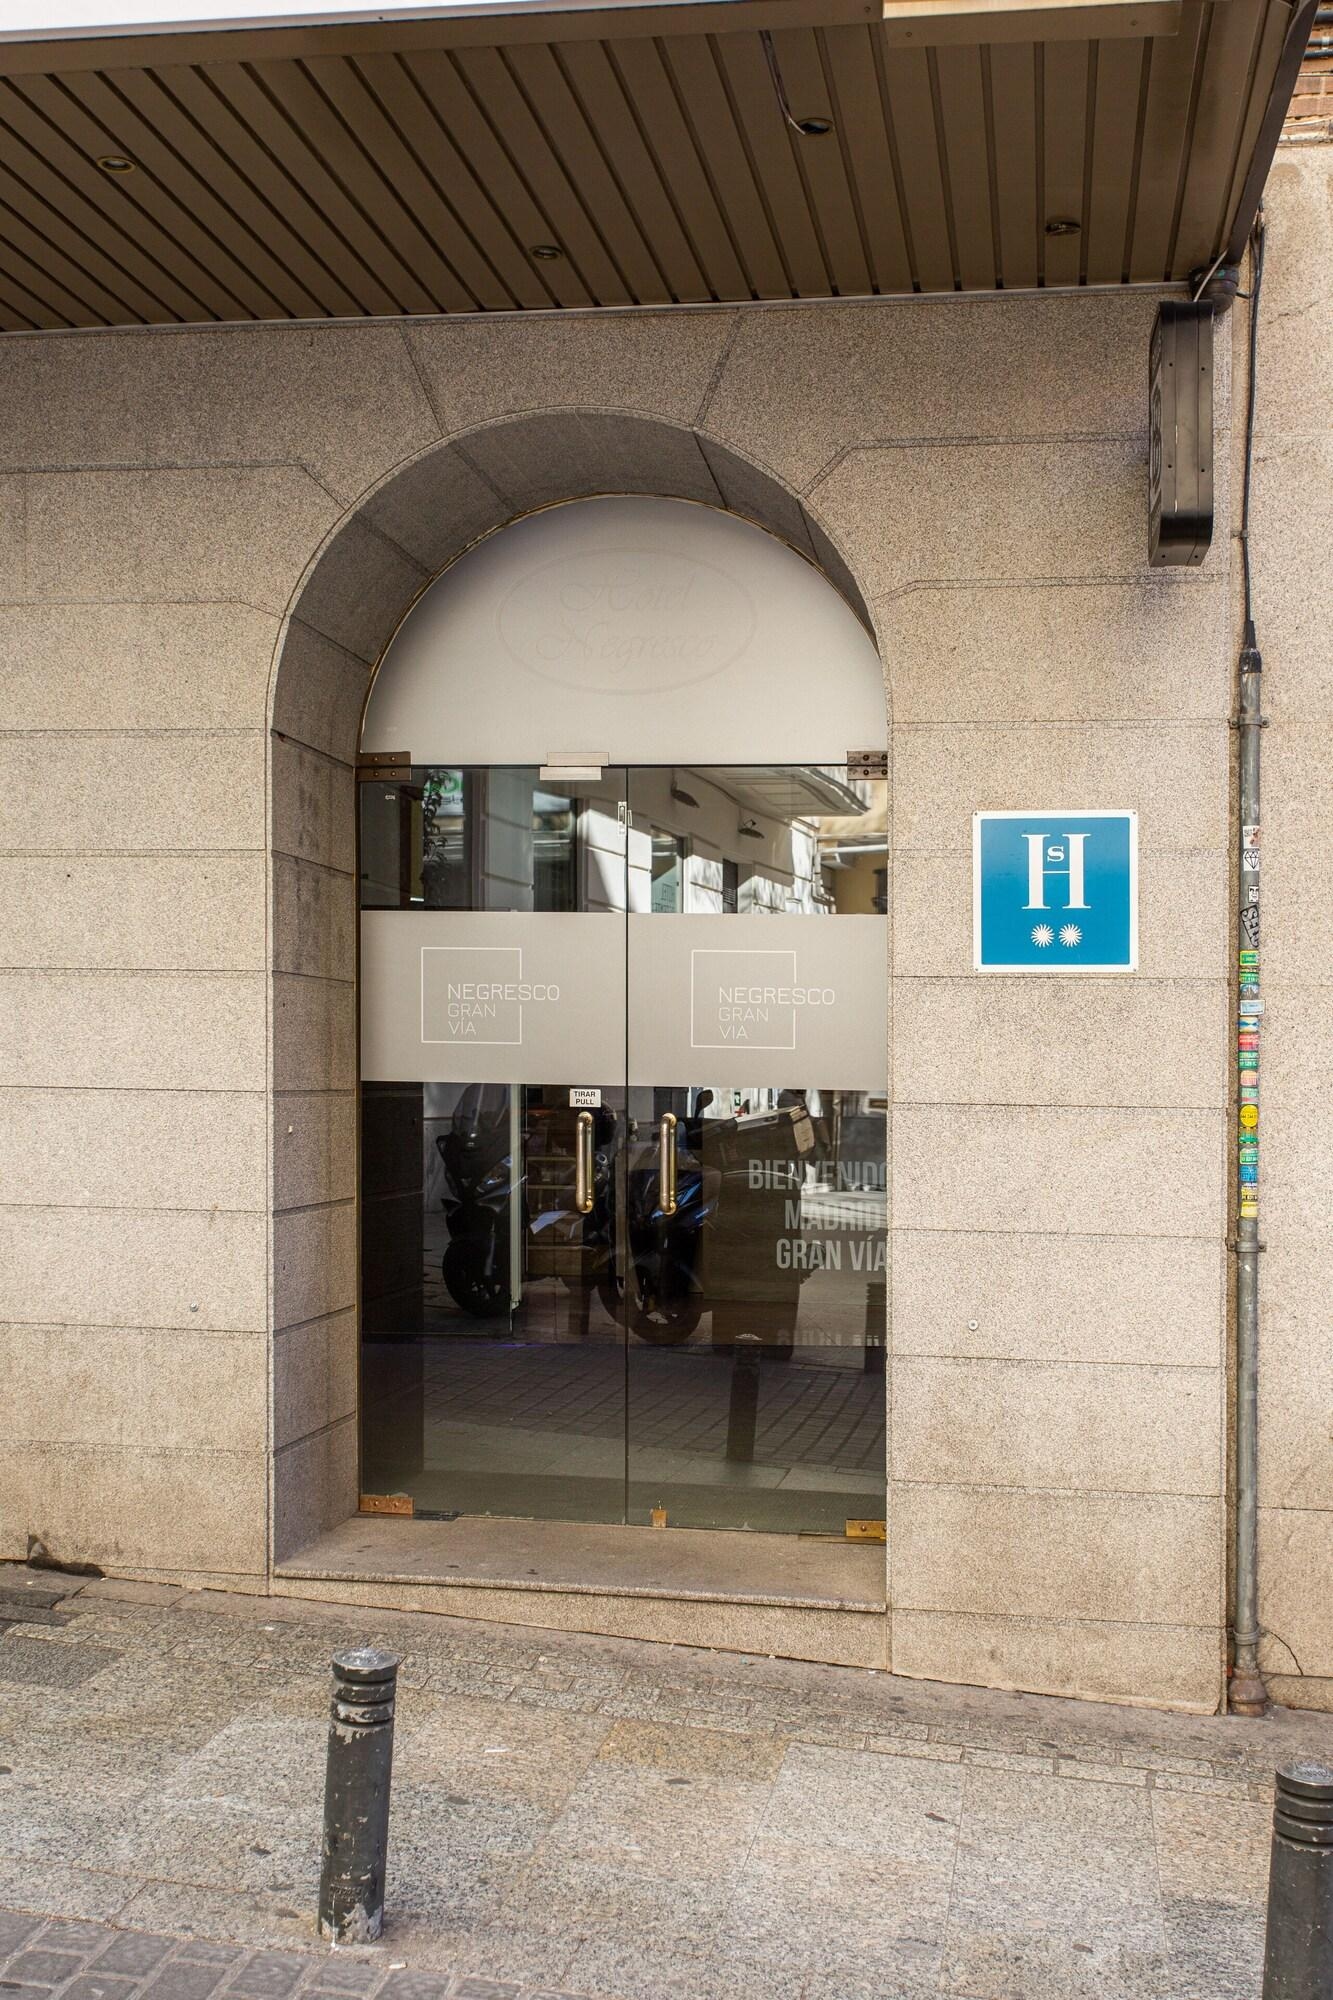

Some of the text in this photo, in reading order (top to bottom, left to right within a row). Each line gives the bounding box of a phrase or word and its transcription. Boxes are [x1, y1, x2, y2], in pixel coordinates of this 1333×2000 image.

[447, 983, 560, 1001] NEGRESCO
[718, 987, 836, 1006] NEGRESCO
[447, 1003, 497, 1017] GRAN
[718, 1008, 769, 1022] GRAN
[448, 1017, 477, 1035] VÍA
[785, 1200, 881, 1231] MADRID
[776, 1235, 887, 1271] GRAN VÍA
